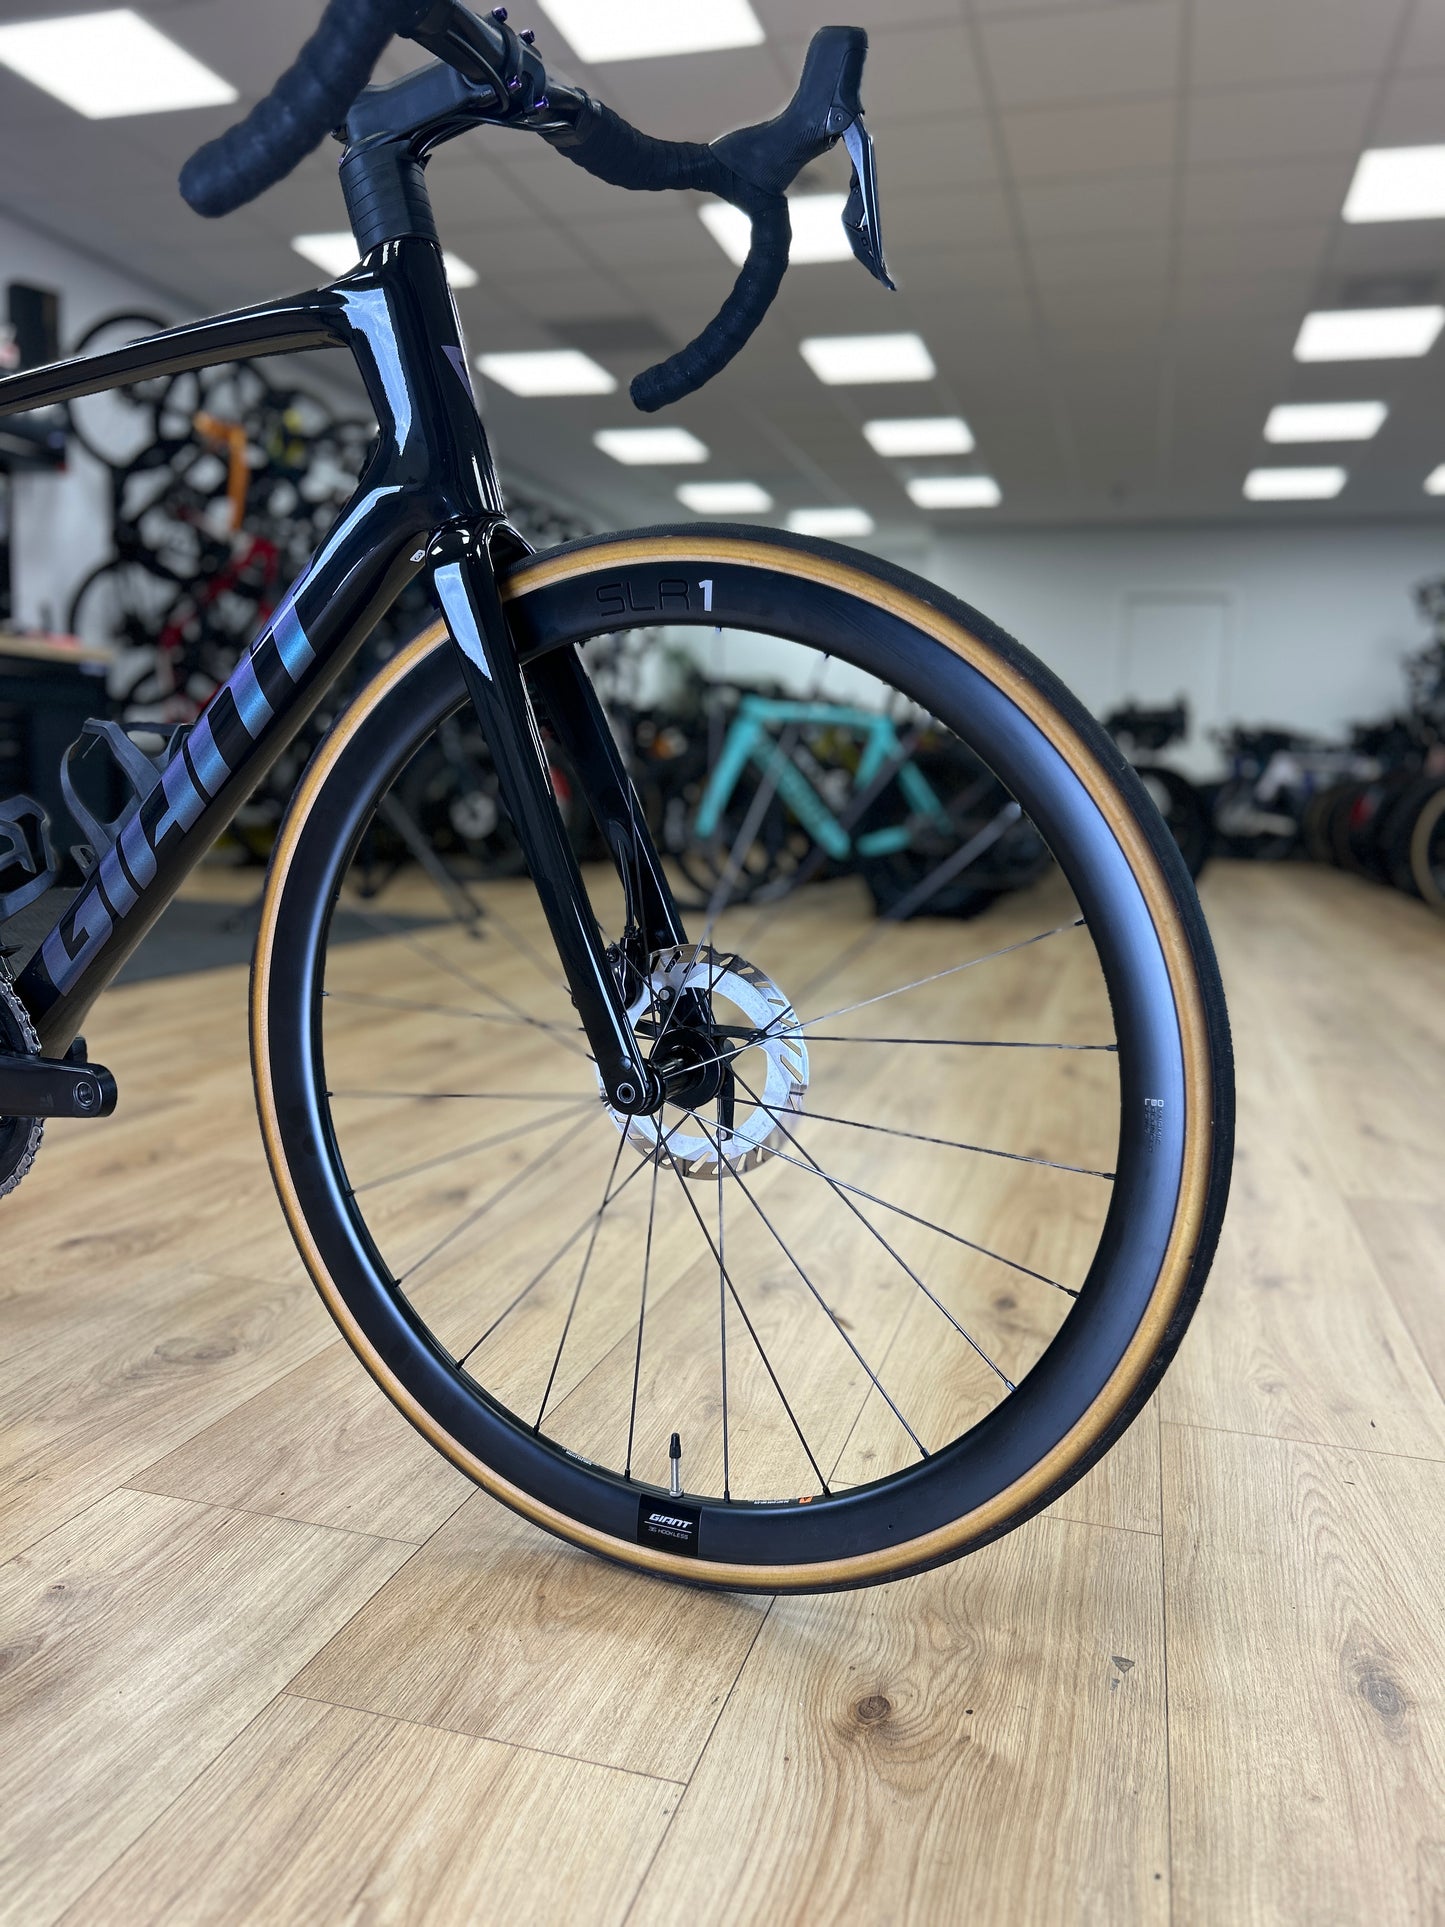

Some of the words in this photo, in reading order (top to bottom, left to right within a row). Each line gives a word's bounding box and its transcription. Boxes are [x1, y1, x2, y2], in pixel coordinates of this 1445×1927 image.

[42, 547, 316, 997] GIANT
[649, 1513, 693, 1528] GIANT
[658, 1528, 689, 1540] HOOKLESS
